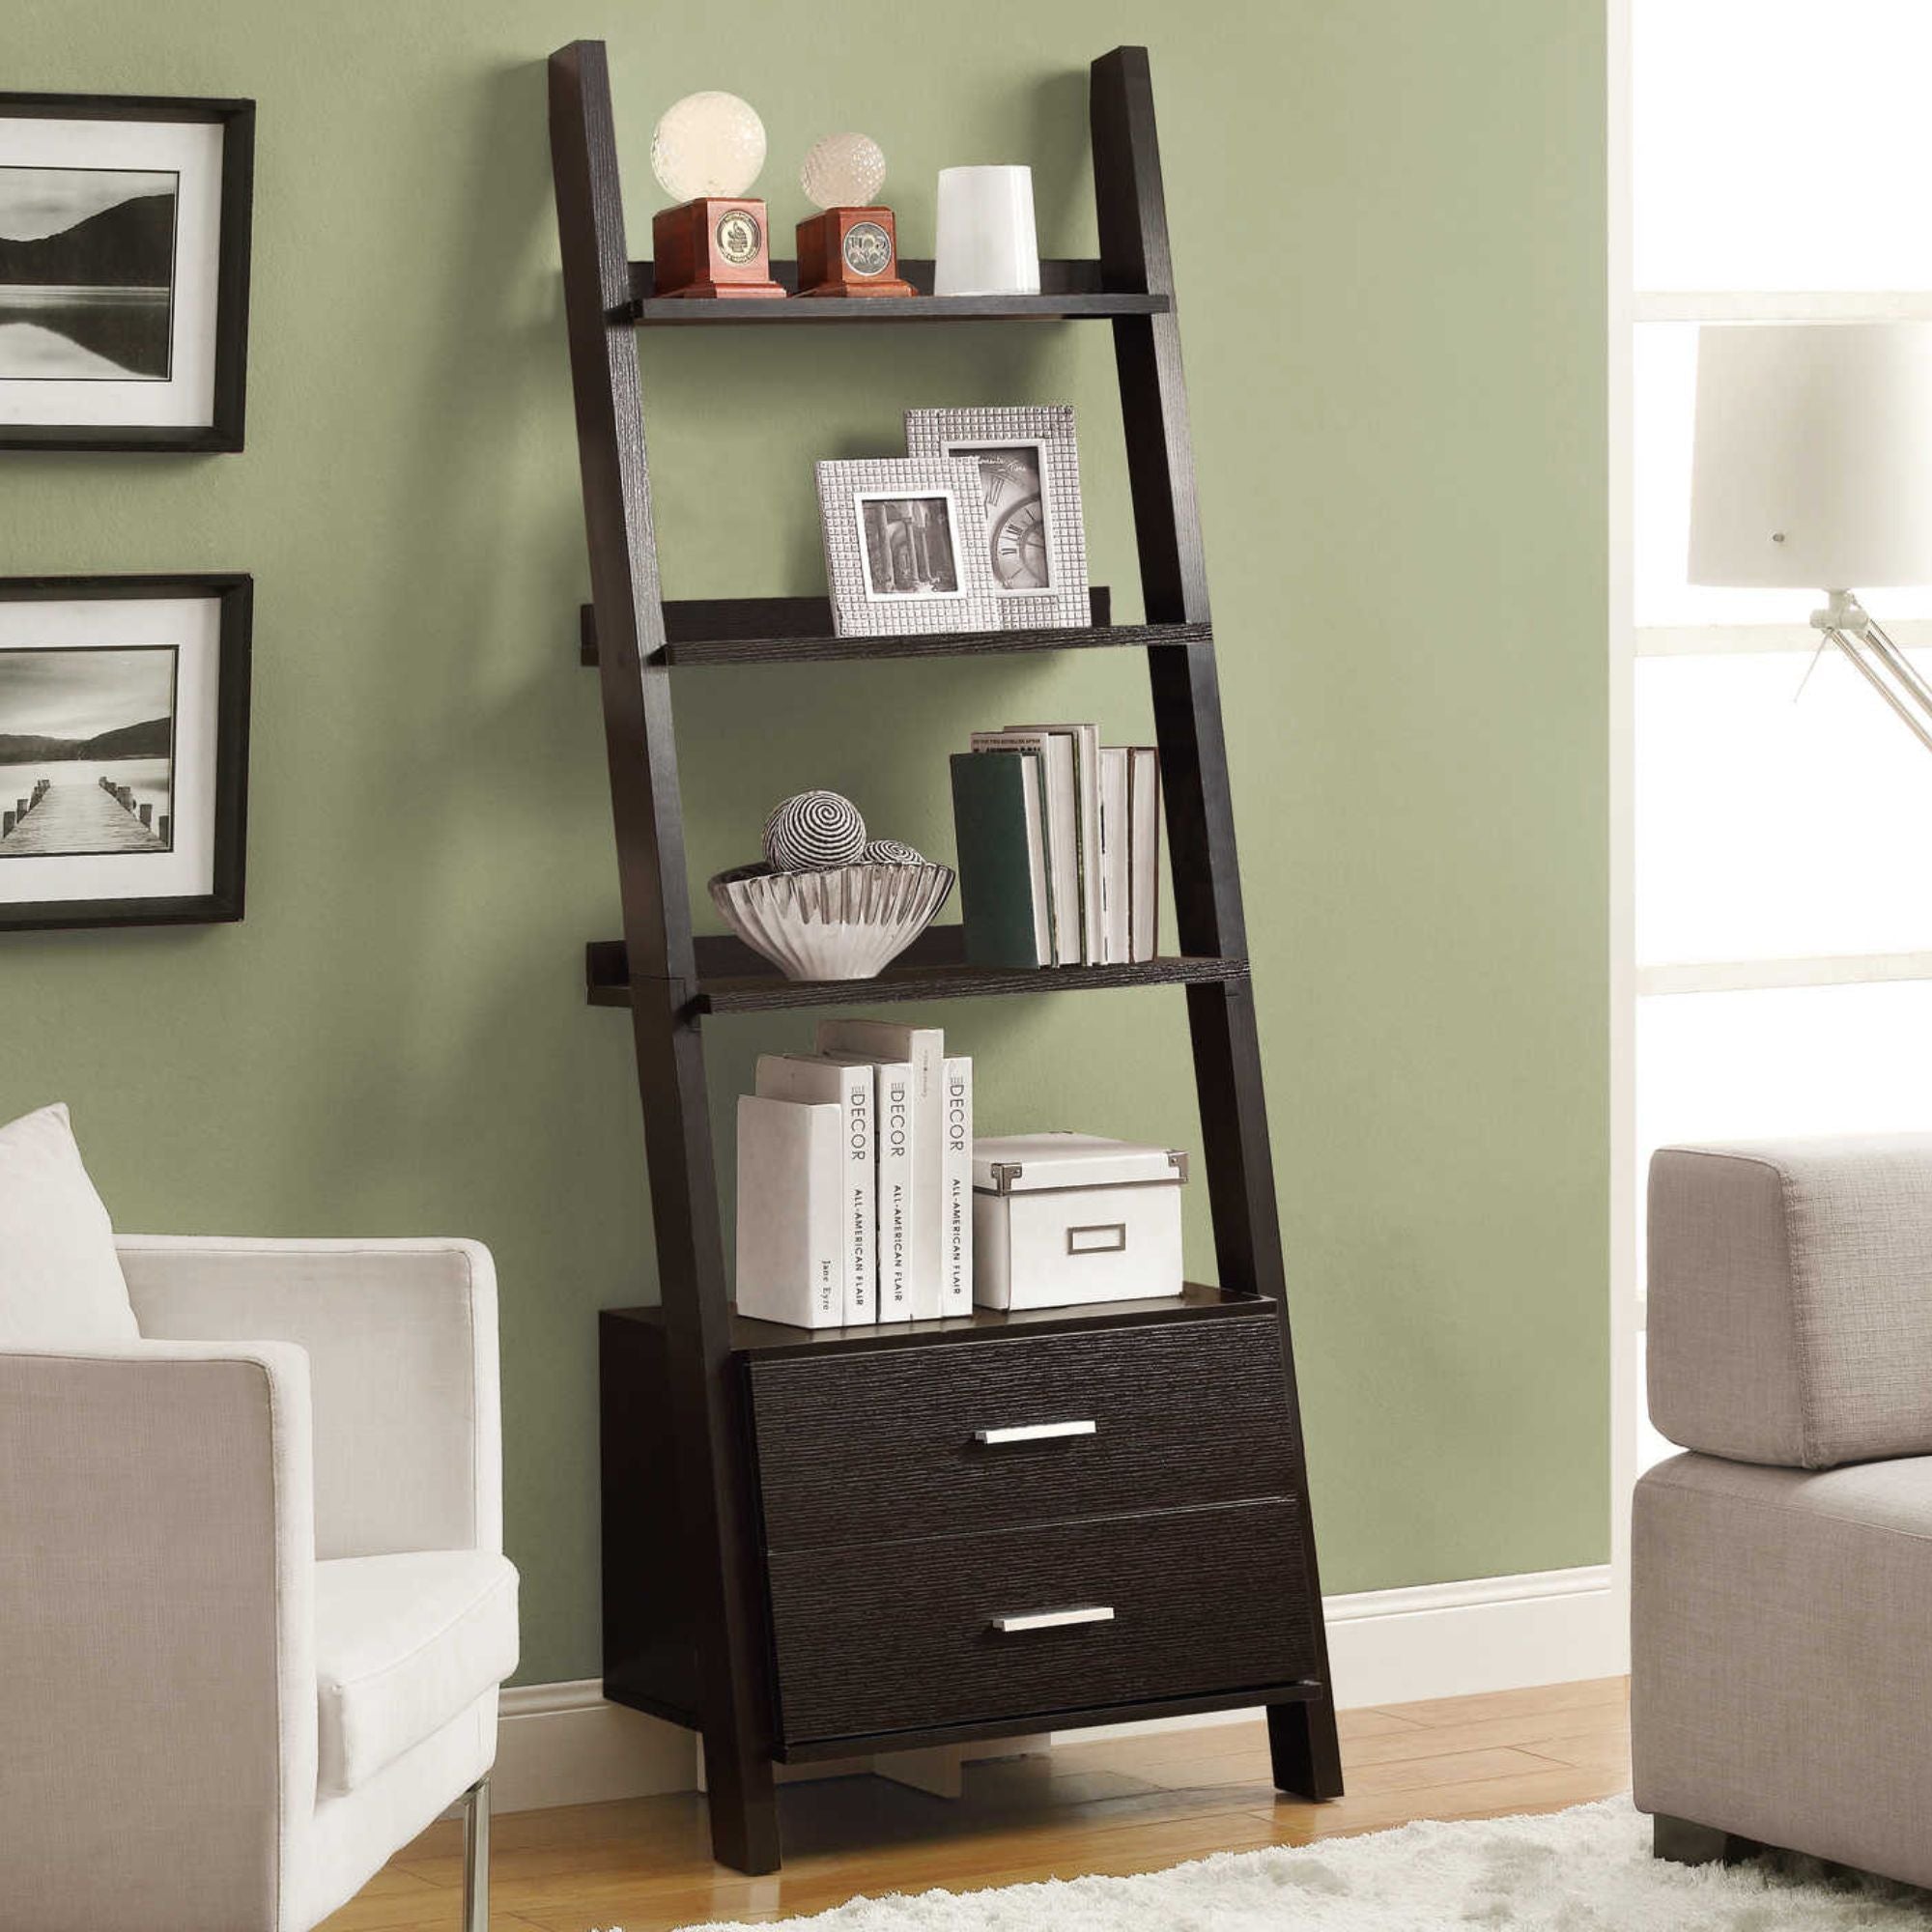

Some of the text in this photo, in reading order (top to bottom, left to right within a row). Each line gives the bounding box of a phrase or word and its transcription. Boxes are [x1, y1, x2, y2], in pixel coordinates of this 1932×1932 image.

[851, 1094, 866, 1160] DECOR
[891, 1091, 905, 1156] DECOR
[950, 1085, 964, 1151] DECOR
[854, 1188, 865, 1306] ALL-AMERICAN FLAIR
[894, 1184, 903, 1301] ALL-AMERICAN FLAIR
[952, 1179, 961, 1294] ALL-AMERICAN FLAIR
[820, 1259, 832, 1311] Jane Eyre
